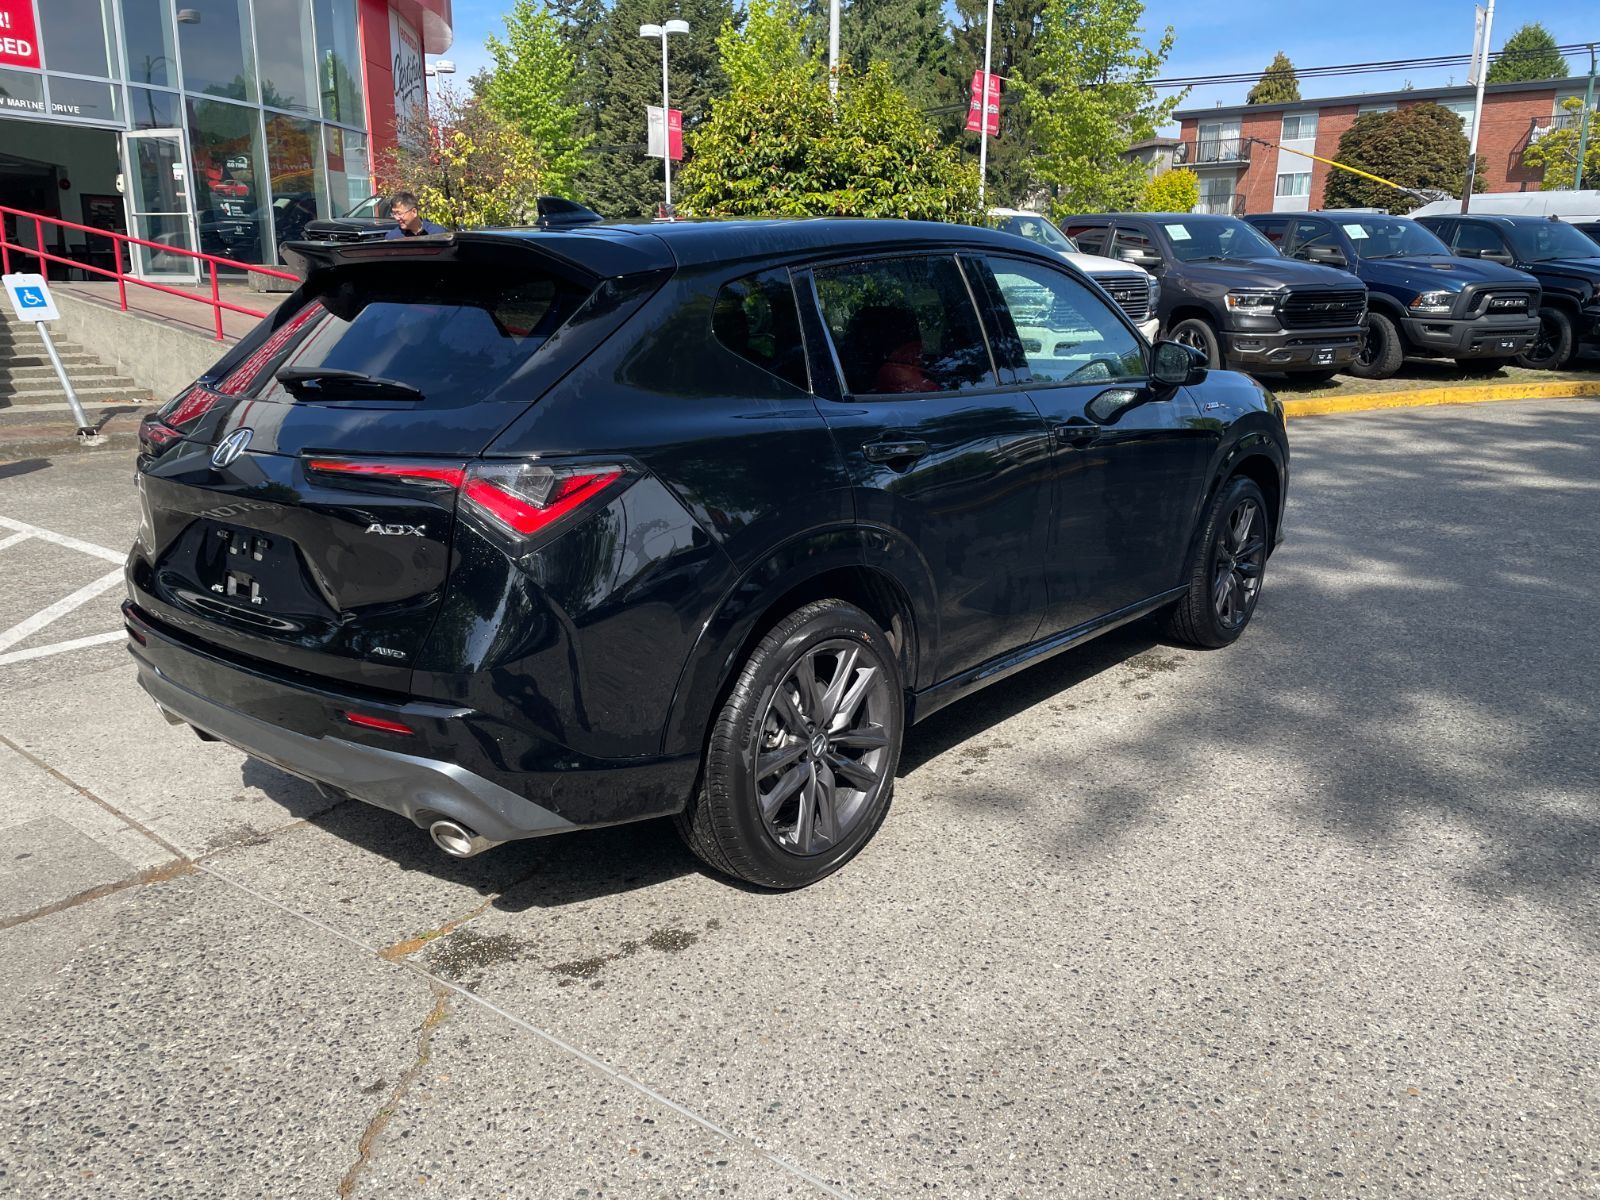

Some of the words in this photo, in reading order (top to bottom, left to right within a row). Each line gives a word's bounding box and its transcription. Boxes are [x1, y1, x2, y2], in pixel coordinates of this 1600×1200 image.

[7, 98, 45, 110] MARINE
[52, 103, 80, 114] DRIVE
[1493, 299, 1526, 307] RAM
[364, 523, 426, 537] ADX
[371, 646, 406, 659] AWD
